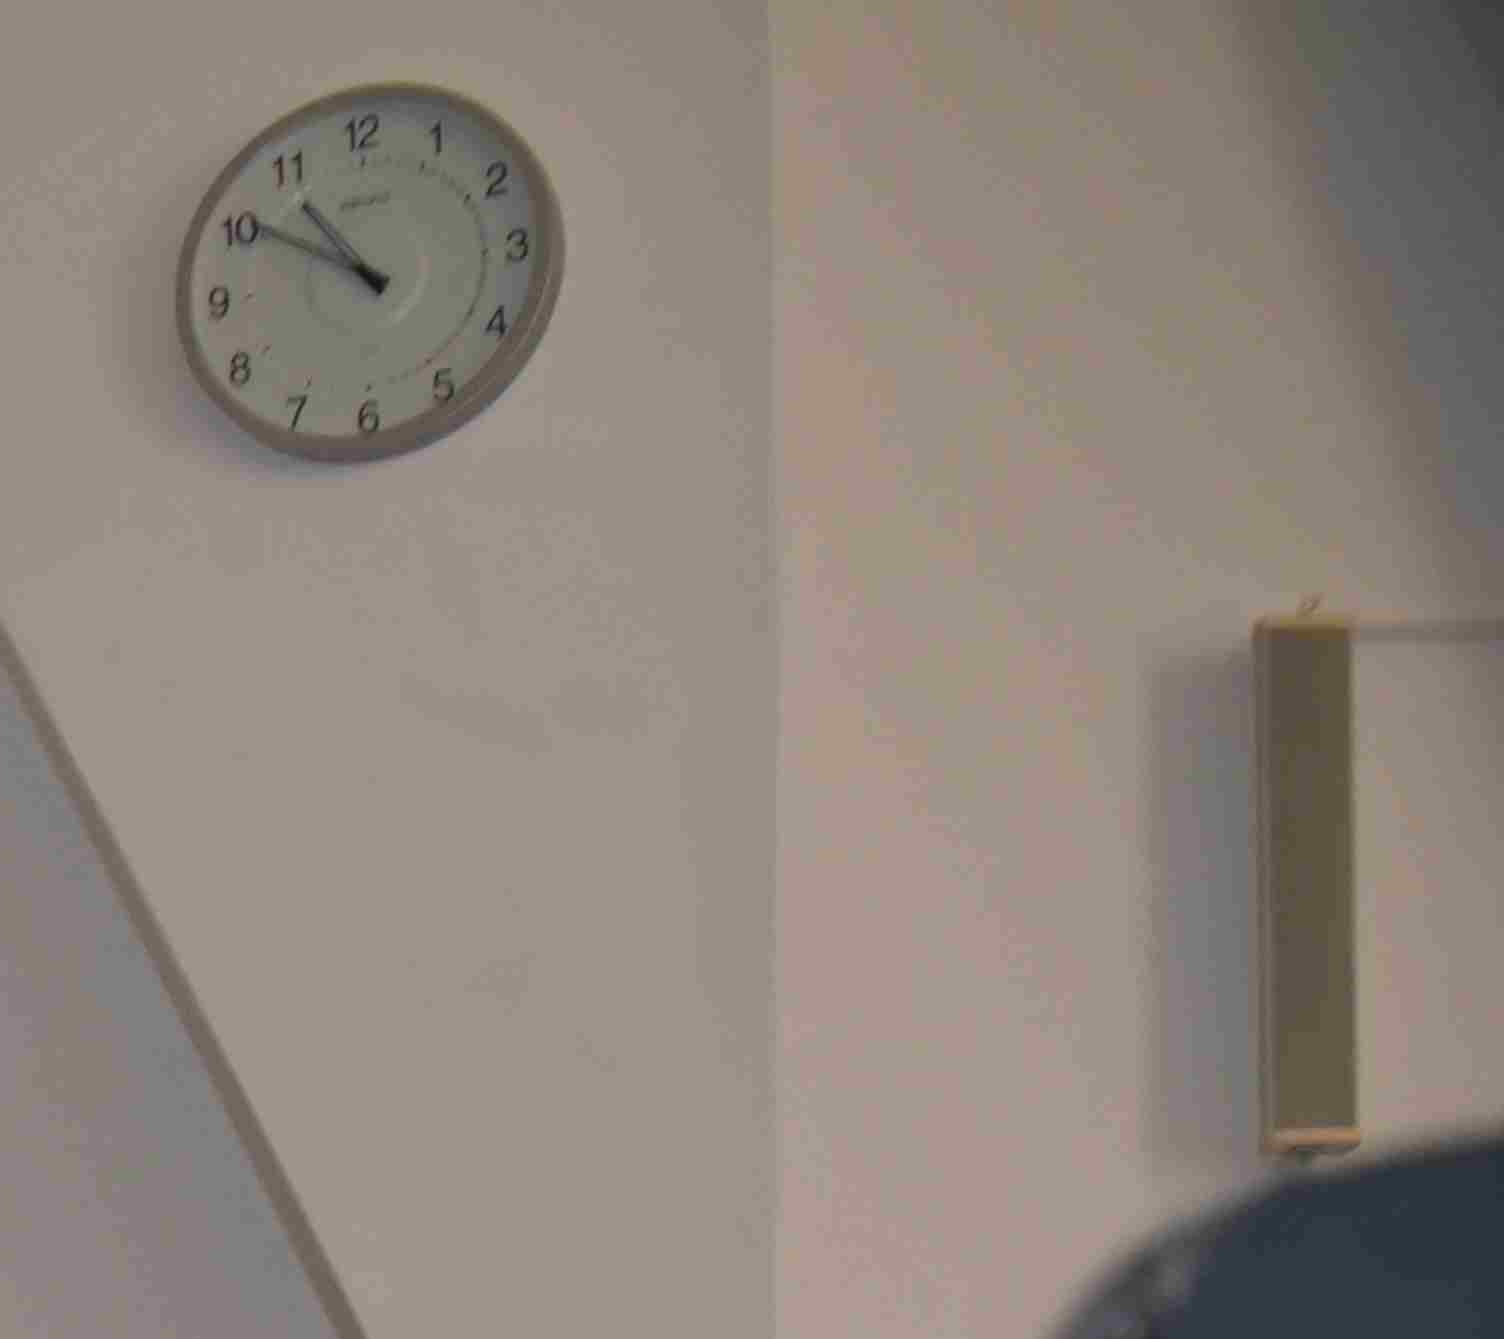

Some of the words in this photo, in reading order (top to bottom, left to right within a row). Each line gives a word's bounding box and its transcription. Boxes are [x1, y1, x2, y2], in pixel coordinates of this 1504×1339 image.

[345, 114, 379, 152] 12
[430, 121, 444, 153] 1
[272, 151, 304, 189] 11
[485, 162, 508, 198] 2
[223, 211, 259, 247] 10
[506, 229, 529, 262] 3
[208, 287, 230, 318] 9
[486, 306, 508, 338] 4
[229, 353, 251, 385] 8
[433, 369, 455, 402] 5
[285, 395, 307, 432] 7
[357, 400, 379, 434] 6
